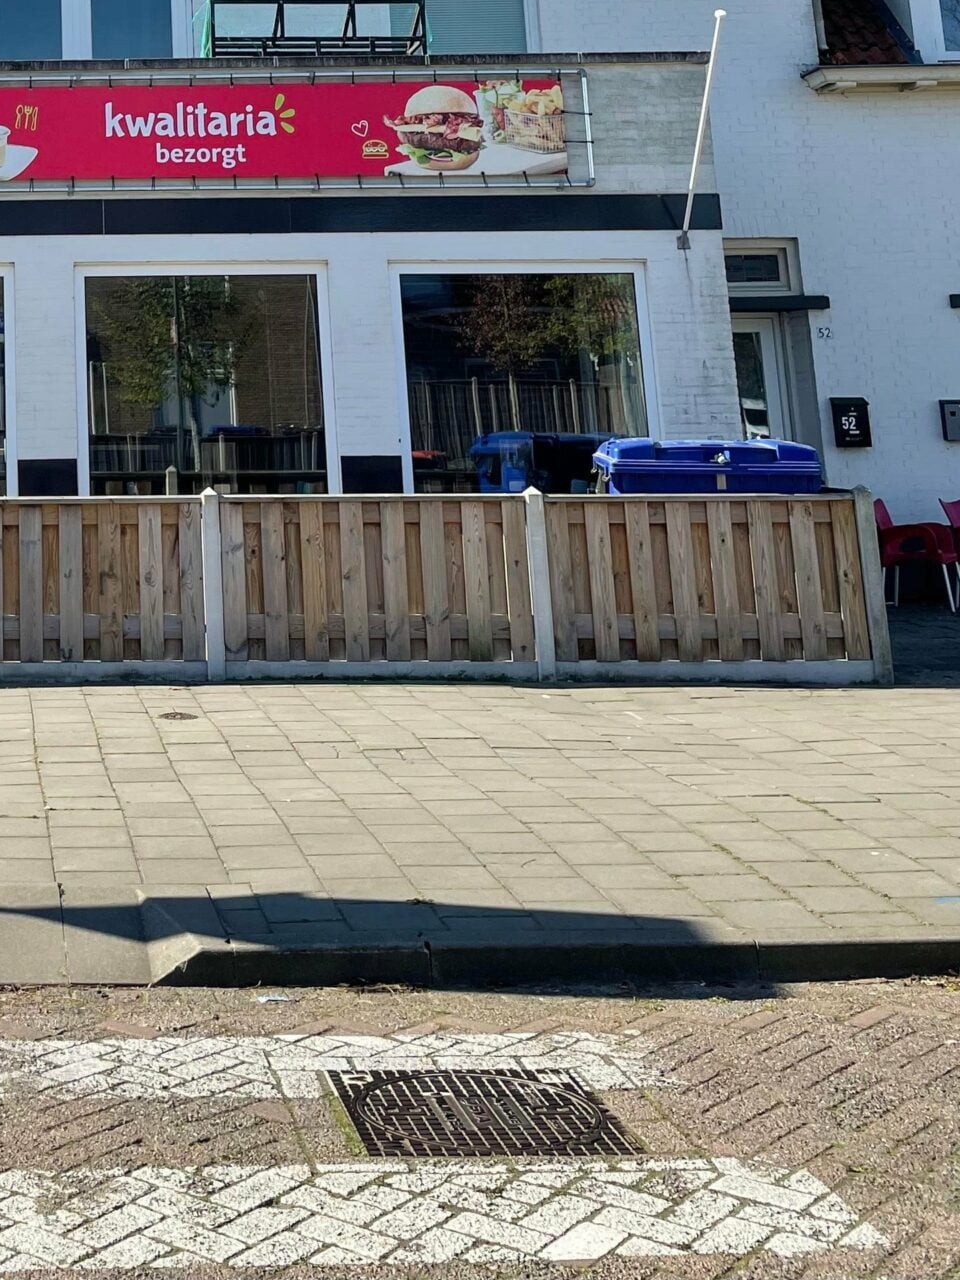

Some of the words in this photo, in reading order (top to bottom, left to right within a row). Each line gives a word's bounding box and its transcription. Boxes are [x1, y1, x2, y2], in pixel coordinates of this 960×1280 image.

[104, 102, 277, 137] kwalitaria
[156, 143, 247, 169] bezorgt
[818, 327, 831, 338] 52
[842, 417, 857, 430] 52
